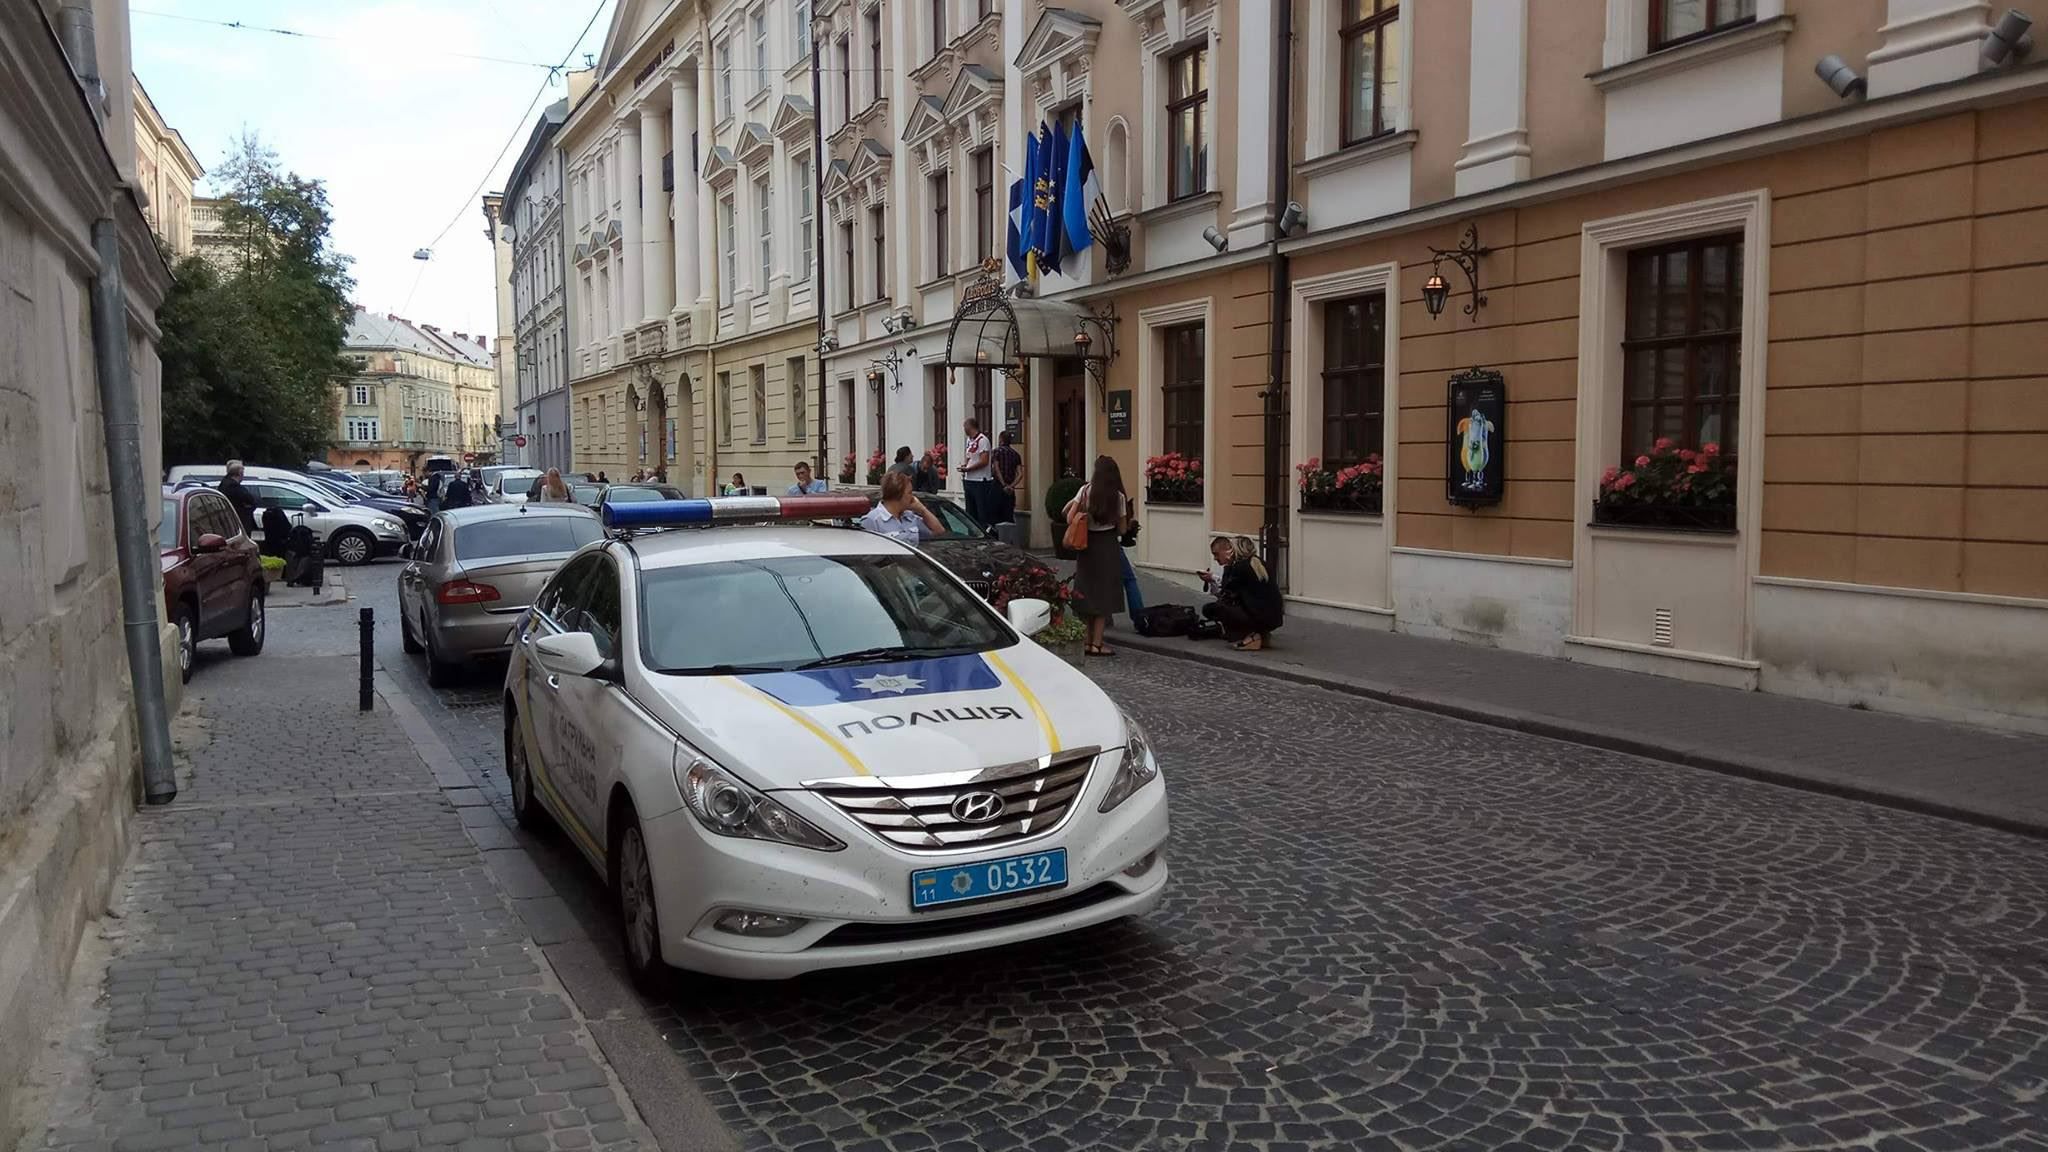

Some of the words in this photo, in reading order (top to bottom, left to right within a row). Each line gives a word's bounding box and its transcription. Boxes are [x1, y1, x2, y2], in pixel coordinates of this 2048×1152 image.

[838, 706, 1023, 738] ПОЛІЦІЯ
[921, 889, 935, 901] 11
[987, 856, 1052, 891] 0532
